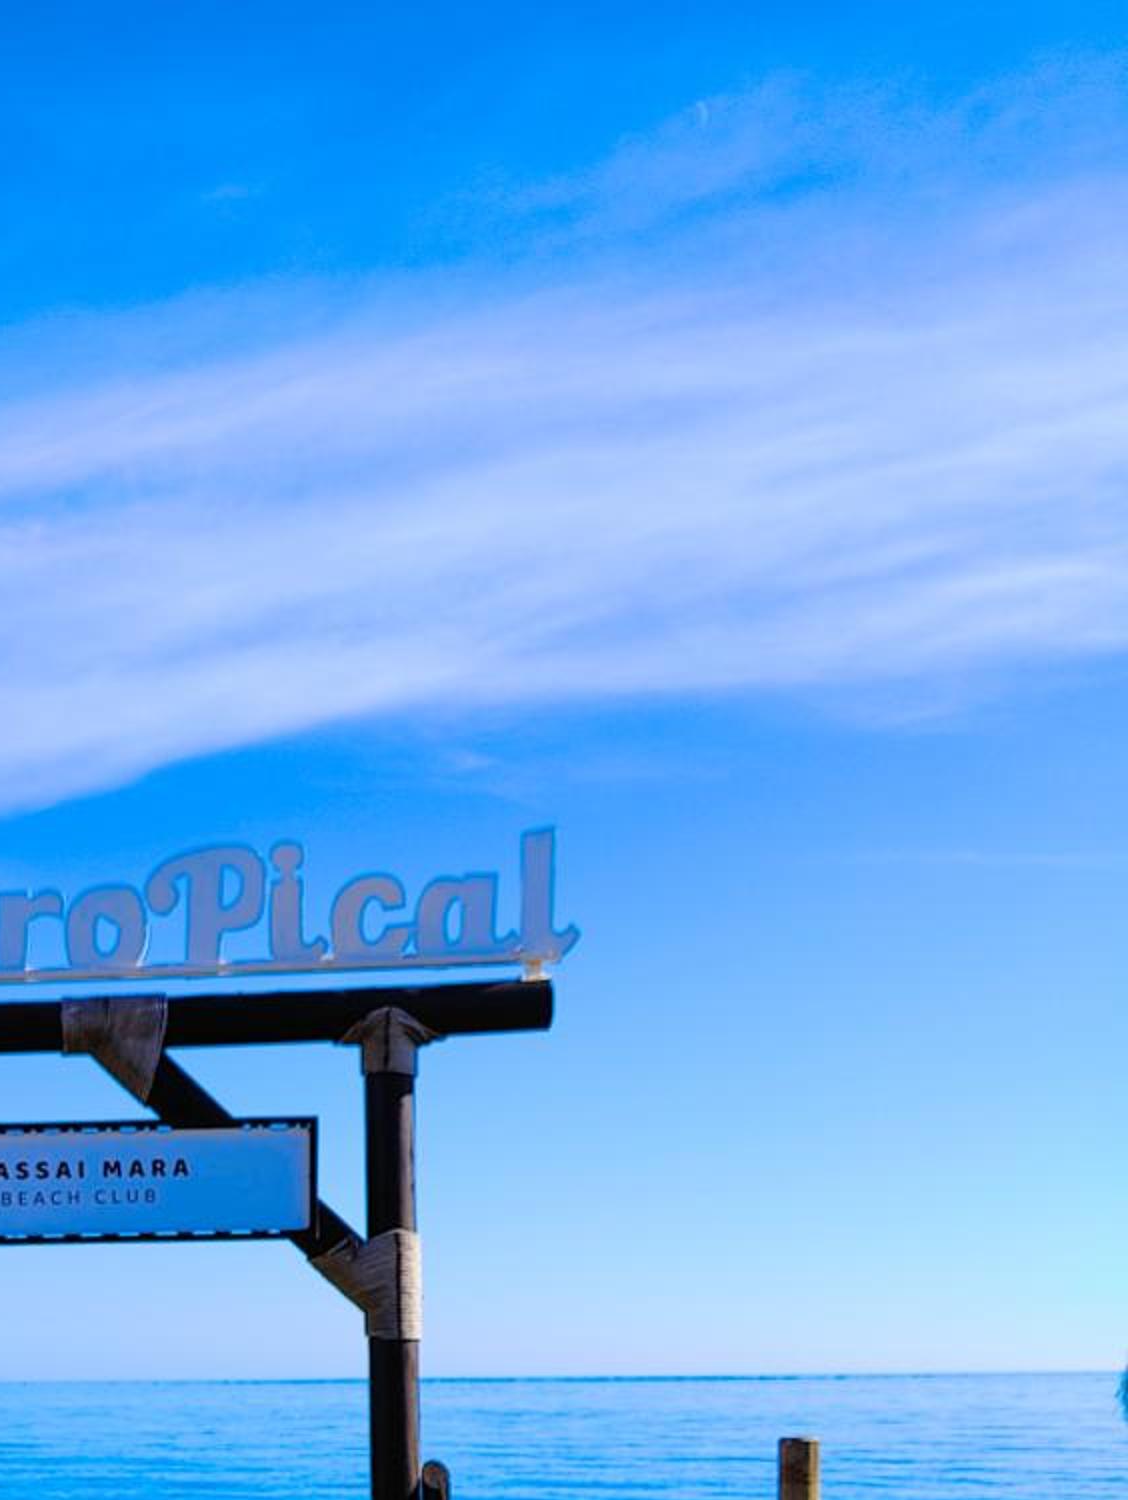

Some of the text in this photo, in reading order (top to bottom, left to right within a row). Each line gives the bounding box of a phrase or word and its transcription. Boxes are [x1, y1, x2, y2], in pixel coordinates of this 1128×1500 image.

[102, 1157, 190, 1179] MARA
[1, 1187, 157, 1208] BEACH CLUB
